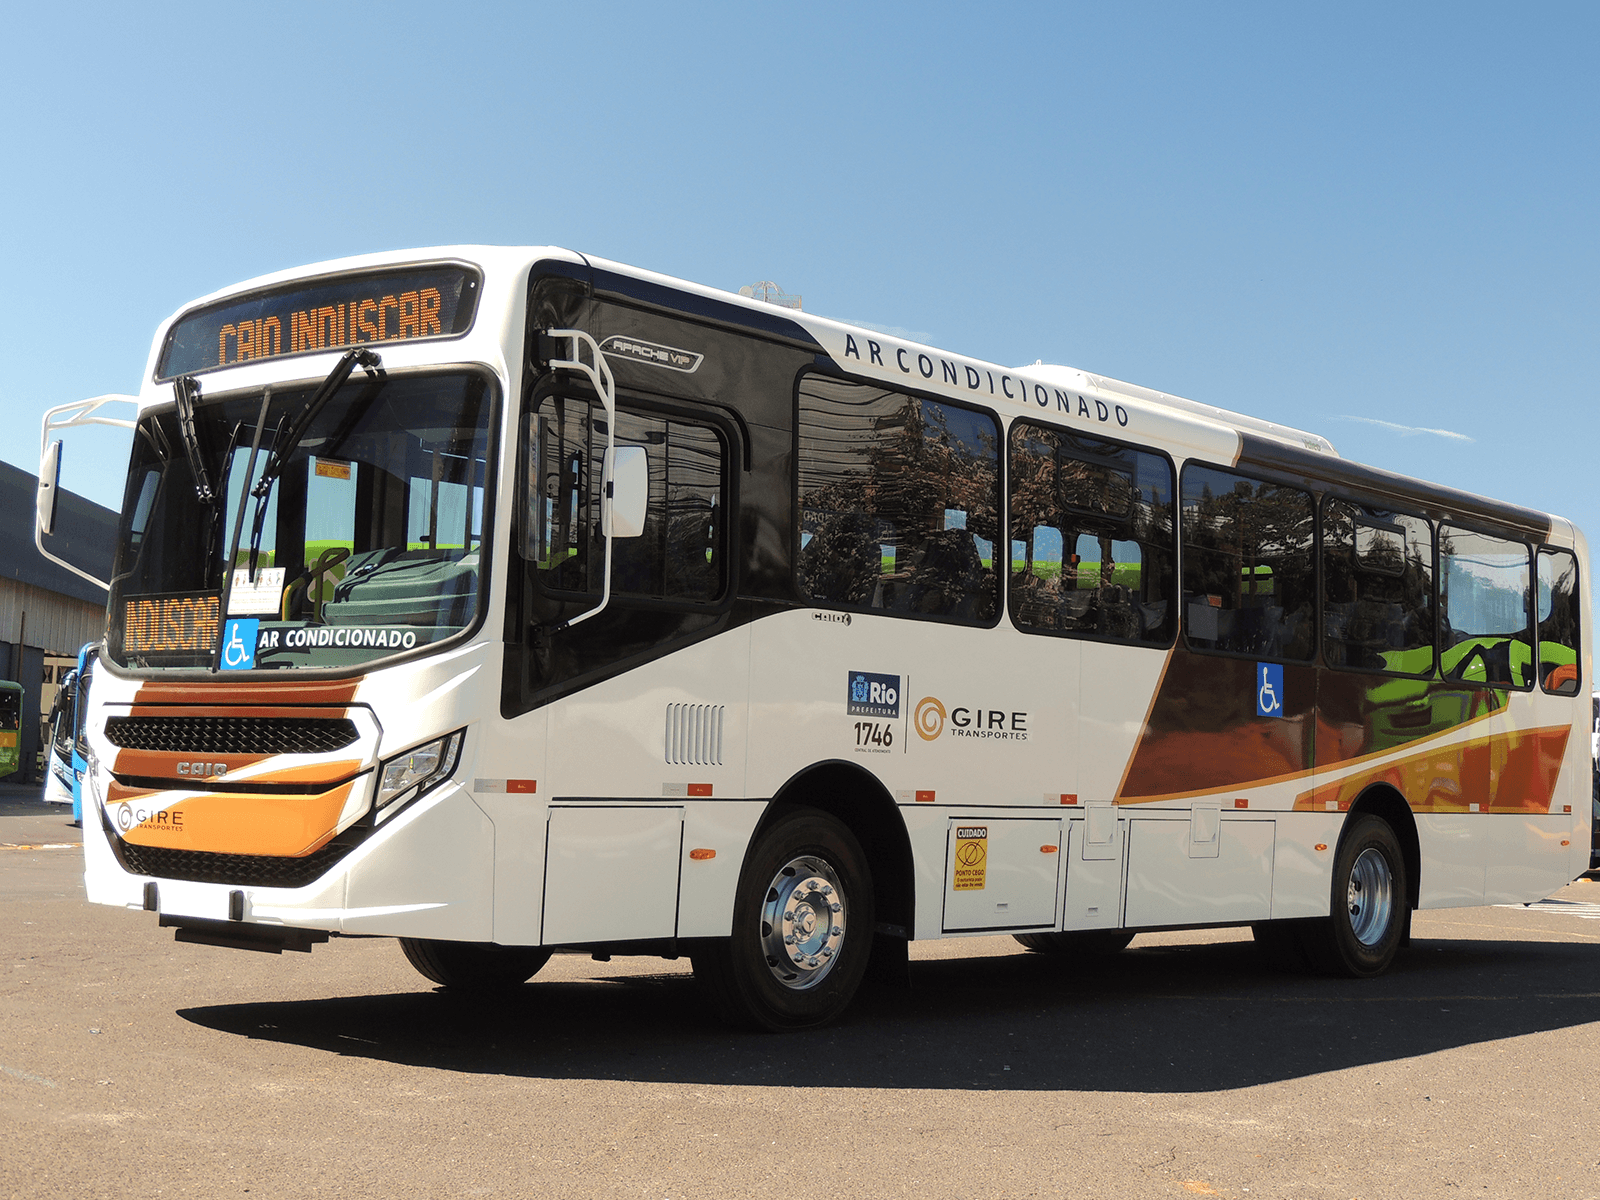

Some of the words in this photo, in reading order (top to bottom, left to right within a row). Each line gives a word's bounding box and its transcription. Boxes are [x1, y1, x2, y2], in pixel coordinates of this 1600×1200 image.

[219, 316, 281, 365] CAIO
[291, 288, 441, 353] INDUSCAR
[613, 340, 669, 362] APACHE
[670, 353, 690, 365] VIP
[845, 334, 884, 366] AR
[896, 348, 1128, 427] CONDICIONADO
[259, 631, 278, 647] AR
[285, 629, 416, 649] CONDICIONADO
[870, 682, 897, 705] Rio
[851, 706, 897, 715] PREFEITURA
[951, 707, 1028, 731] GIRE
[854, 722, 893, 747] 1746
[951, 729, 1028, 741] TRANSPORTES
[177, 762, 228, 776] CAIO
[136, 809, 184, 825] GIRE
[136, 823, 184, 832] TRANSPORTES
[957, 828, 986, 838] CUIDADO
